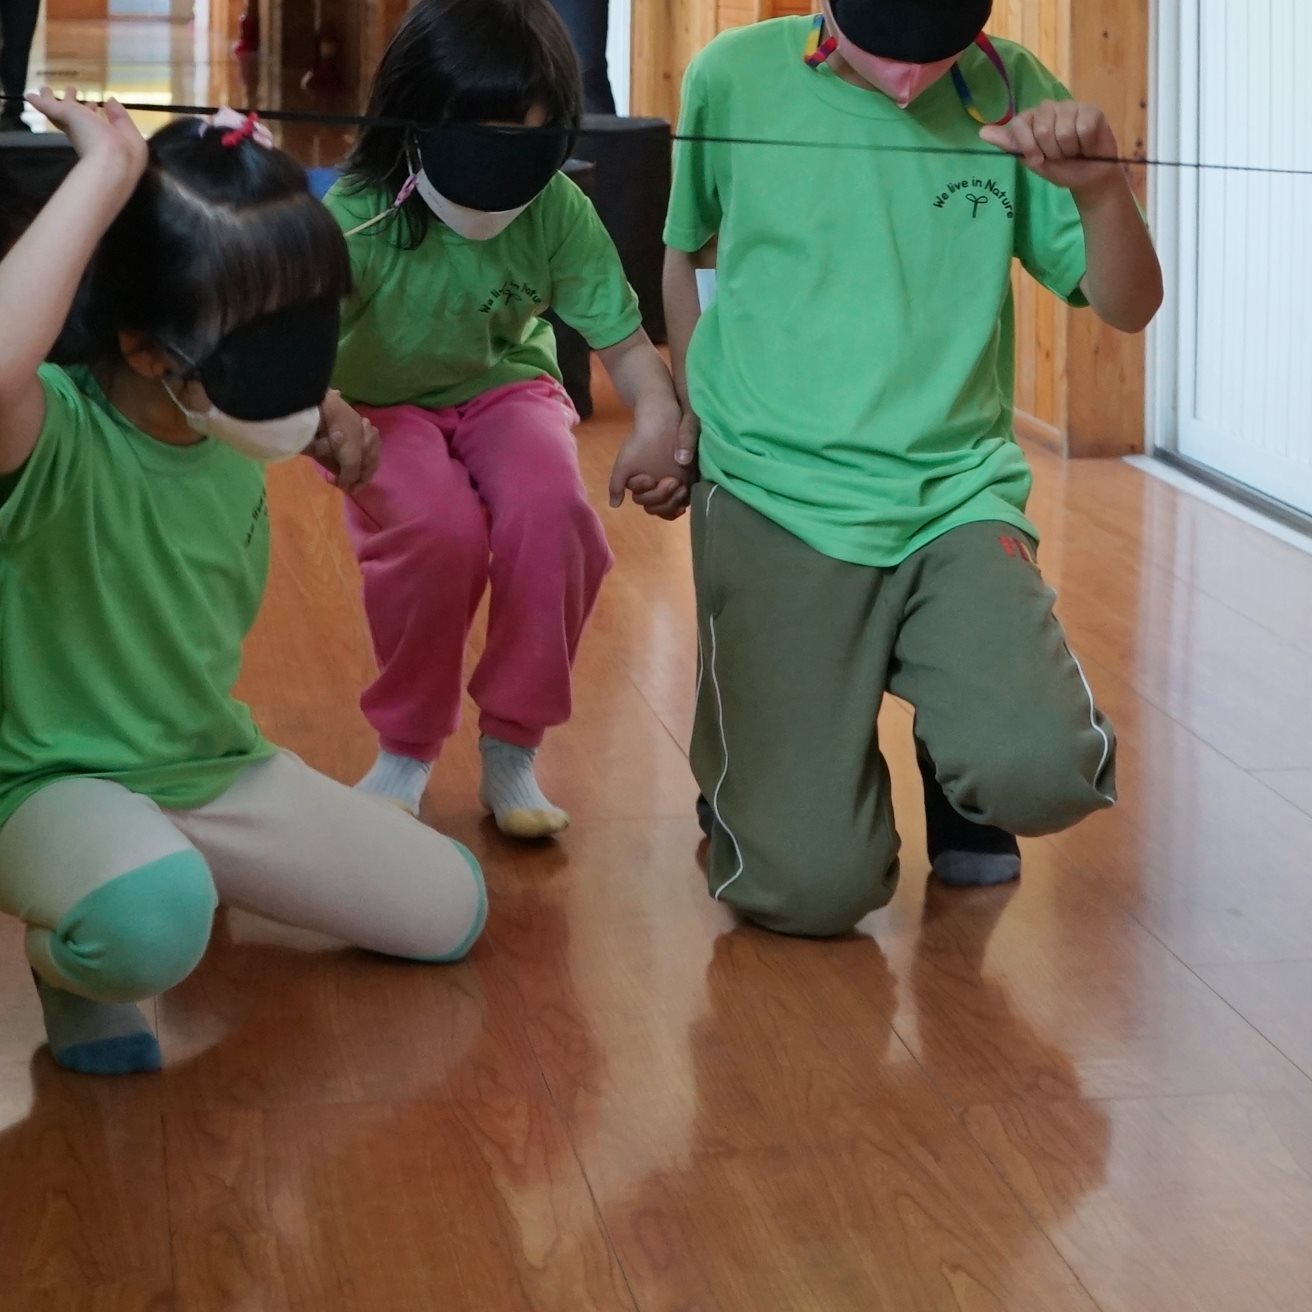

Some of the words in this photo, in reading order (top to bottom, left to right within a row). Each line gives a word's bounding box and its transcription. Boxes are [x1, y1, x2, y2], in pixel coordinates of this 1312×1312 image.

[933, 191, 950, 209] We
[946, 177, 969, 195] live
[971, 176, 983, 188] in
[984, 178, 1015, 220] Nature
